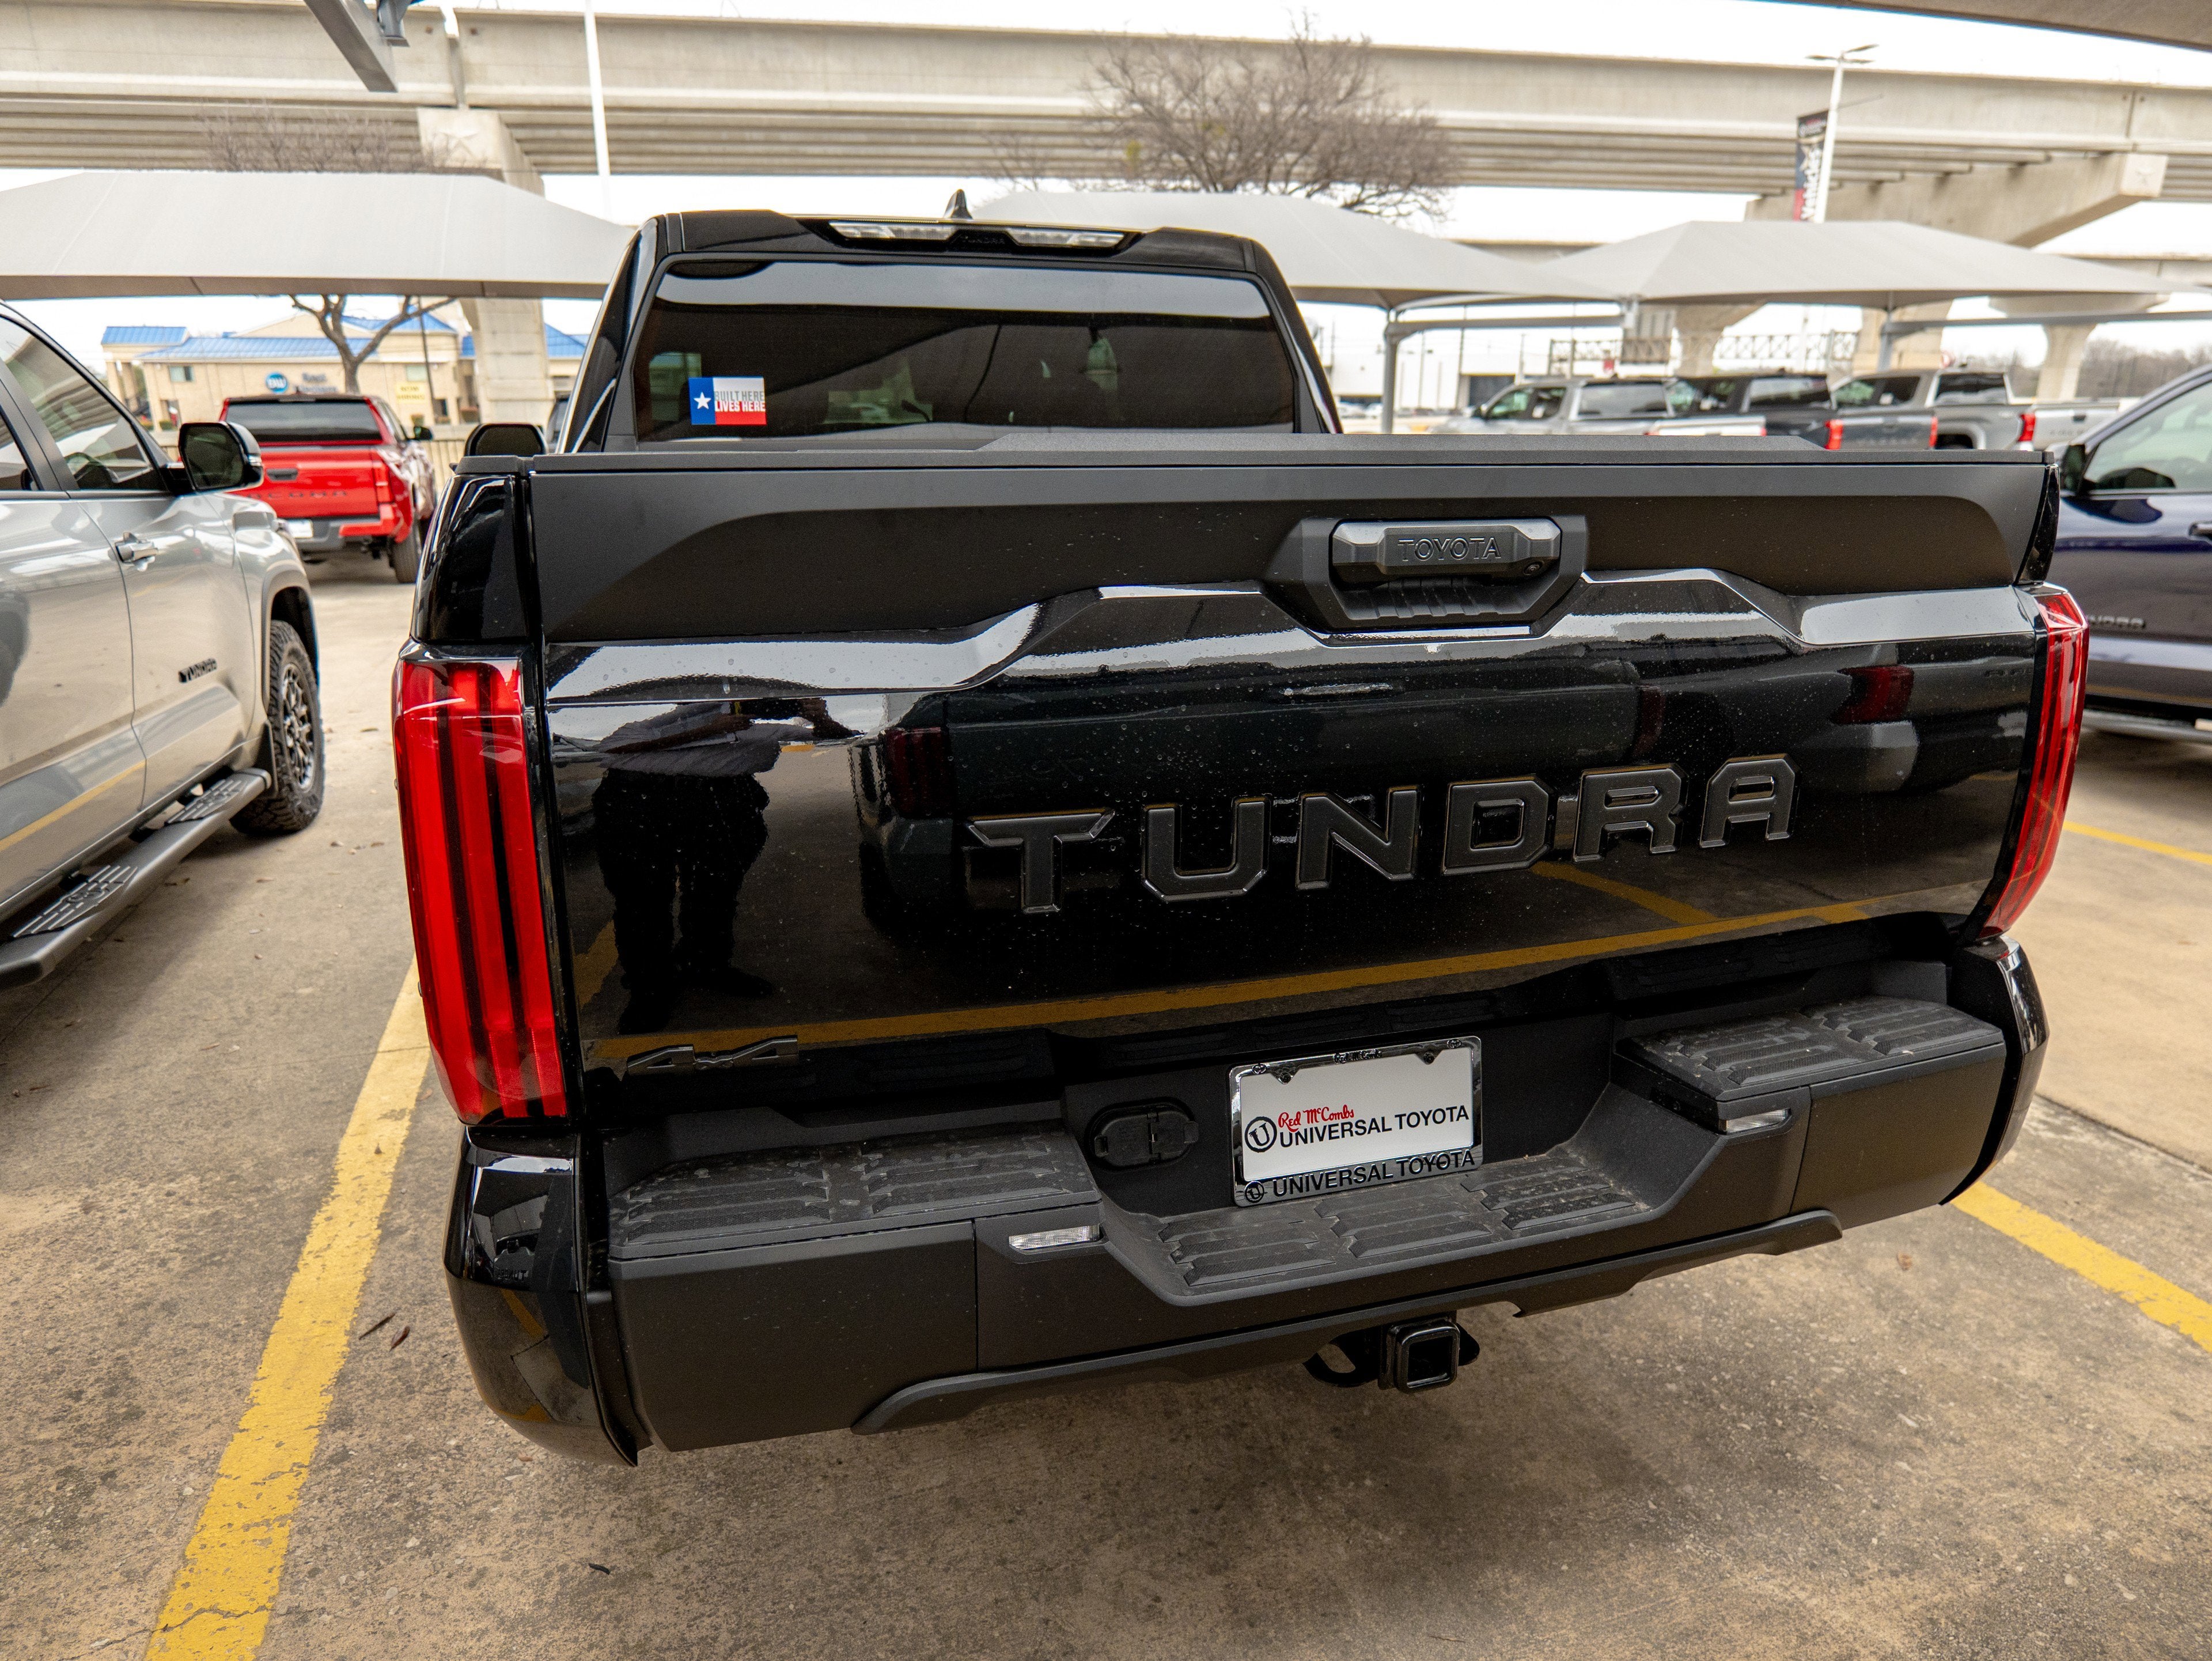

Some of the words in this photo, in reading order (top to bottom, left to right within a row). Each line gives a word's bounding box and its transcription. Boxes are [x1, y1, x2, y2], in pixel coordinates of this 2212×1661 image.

[715, 391, 739, 401] BUILT
[742, 391, 764, 401] HERE
[715, 401, 740, 412] LIVES
[741, 402, 766, 412] HERE
[1397, 537, 1501, 562] TOYOTA
[967, 752, 1800, 914] TUNDRA
[1278, 1111, 1301, 1133] Red
[1302, 1104, 1354, 1124] McCombs
[1279, 1116, 1392, 1148] UNIVERSAL
[1394, 1105, 1469, 1130] TOYOTA
[1272, 1161, 1394, 1197] UNIVERSAL
[1395, 1149, 1475, 1176] TOYOTA
